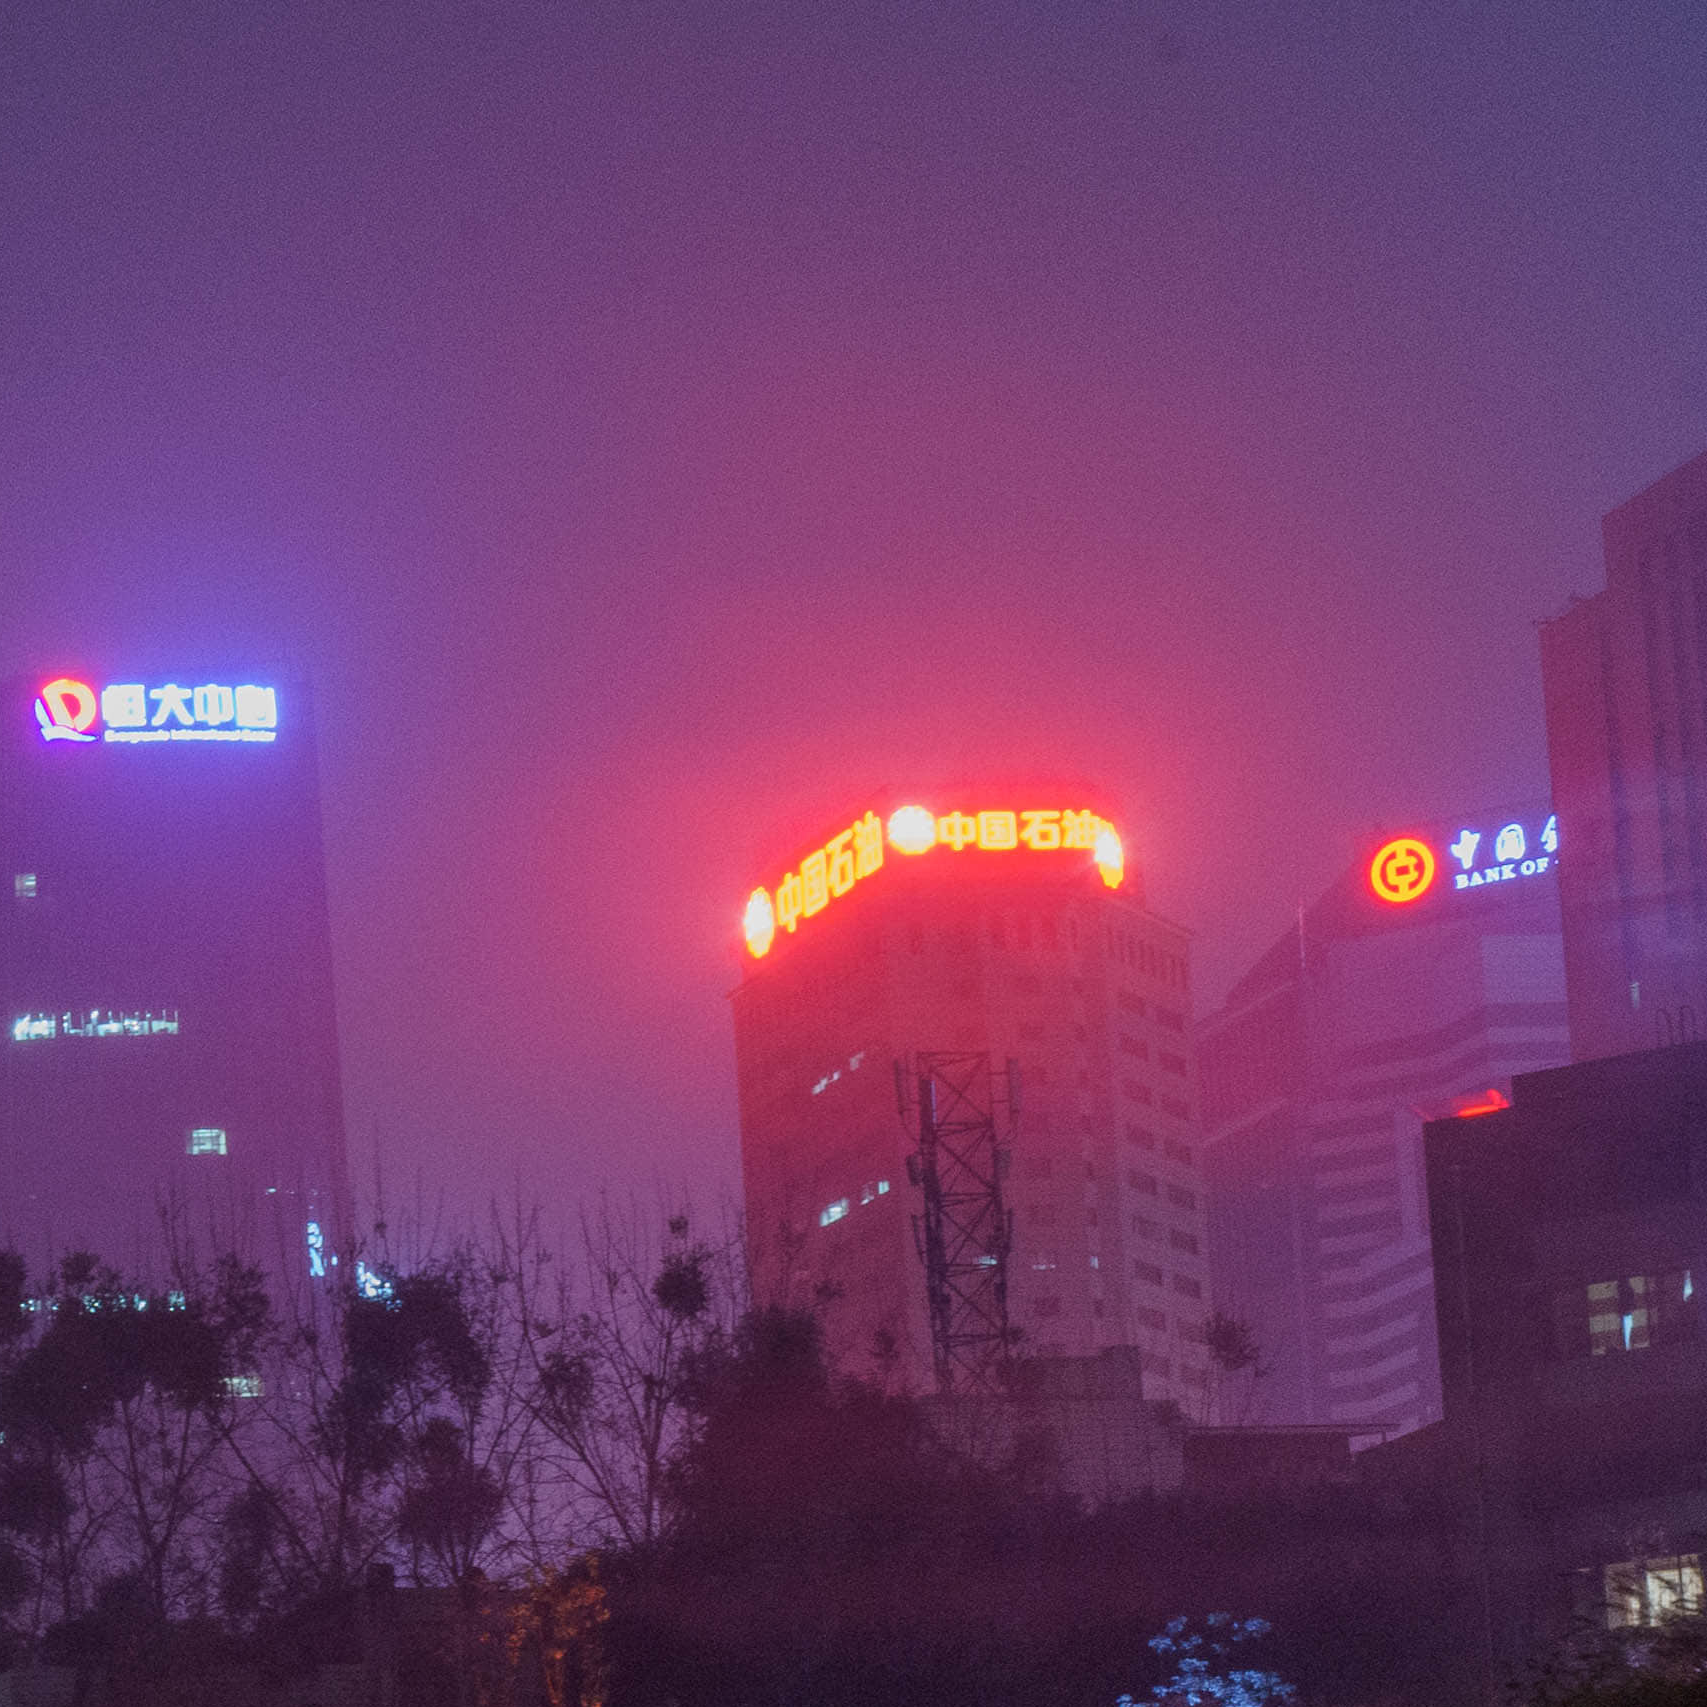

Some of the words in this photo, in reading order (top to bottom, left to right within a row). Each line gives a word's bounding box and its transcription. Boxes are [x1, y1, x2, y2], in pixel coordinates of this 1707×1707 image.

[939, 810, 1100, 850] 中国石油
[776, 811, 883, 933] 中国石油
[1455, 863, 1517, 889] BANK
[1520, 857, 1549, 876] OF
